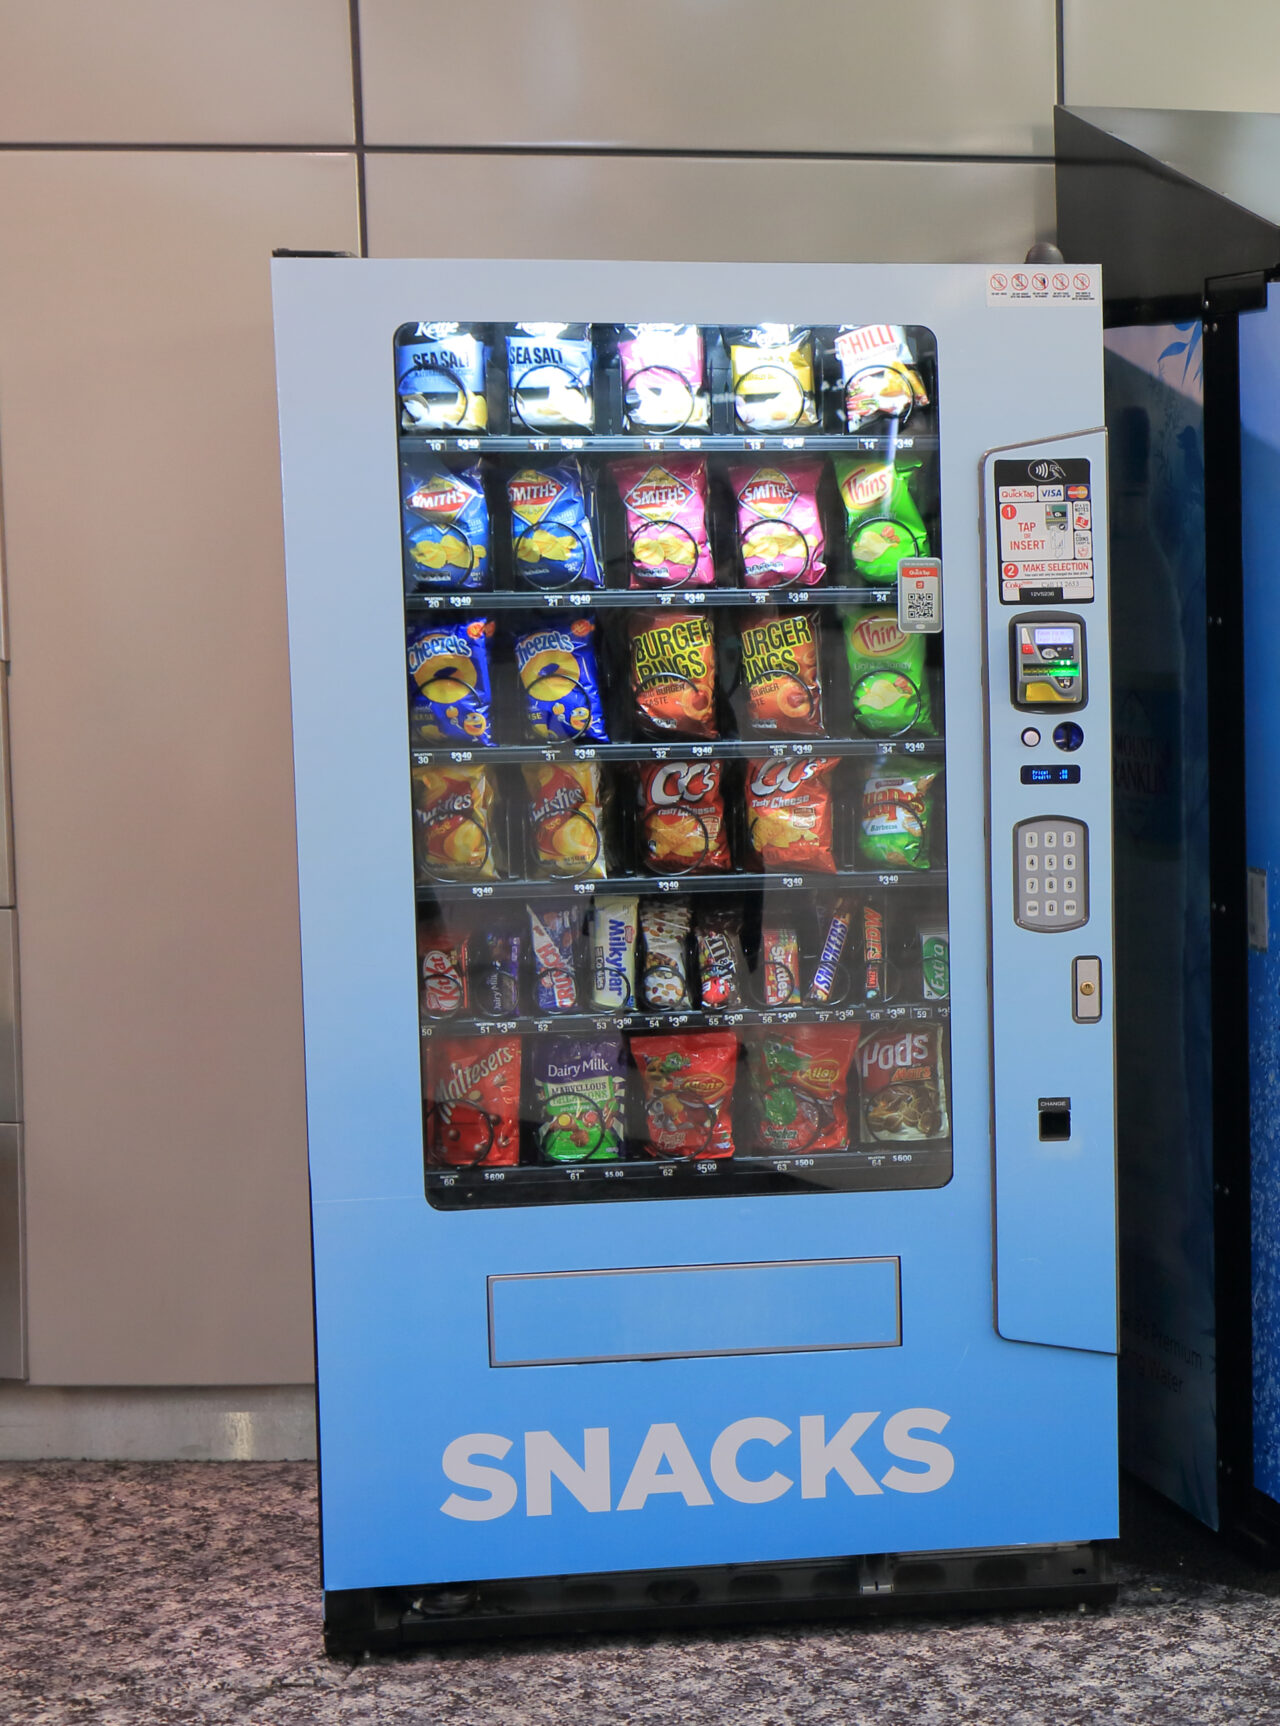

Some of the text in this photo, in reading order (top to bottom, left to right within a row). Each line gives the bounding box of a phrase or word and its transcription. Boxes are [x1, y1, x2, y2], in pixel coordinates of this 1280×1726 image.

[412, 351, 439, 369] SEA
[509, 347, 563, 365] SEA SALT
[430, 442, 441, 451] 10
[751, 441, 761, 450] 13
[864, 441, 875, 450] 14
[842, 468, 888, 503] Thins
[1041, 489, 1062, 497] VISA
[1018, 522, 1036, 532] TAP
[1010, 539, 1045, 551] INSERT
[1022, 564, 1046, 573] MAKE
[1047, 562, 1089, 572] SELECTION
[548, 598, 559, 606] 21
[661, 596, 672, 604] 22
[755, 595, 766, 603] 23
[876, 593, 887, 602] 24
[428, 600, 439, 608] 20
[742, 615, 812, 659] URGER
[743, 649, 800, 687] INGS
[546, 752, 556, 761] 31
[656, 750, 666, 759] 32
[773, 748, 784, 756] 33
[418, 756, 429, 765] 30
[751, 795, 810, 809] Tasty Cheese
[608, 918, 627, 996] Milkybar
[708, 1017, 719, 1026] 55
[762, 1015, 773, 1024] 56
[819, 1013, 830, 1021] 57
[537, 1023, 549, 1032] 52
[596, 1020, 607, 1029] 53
[649, 1019, 660, 1028] 54
[422, 1028, 432, 1036] 50
[480, 1024, 490, 1033] 51
[548, 1060, 581, 1078] Dairy
[436, 1045, 514, 1118] Maltesers
[551, 1081, 607, 1096] MARVELLOUS
[776, 1163, 787, 1171] 63
[570, 1172, 580, 1181] 61
[662, 1168, 674, 1177] 62
[444, 1178, 455, 1186] 60
[439, 1407, 955, 1522] SNACKS
